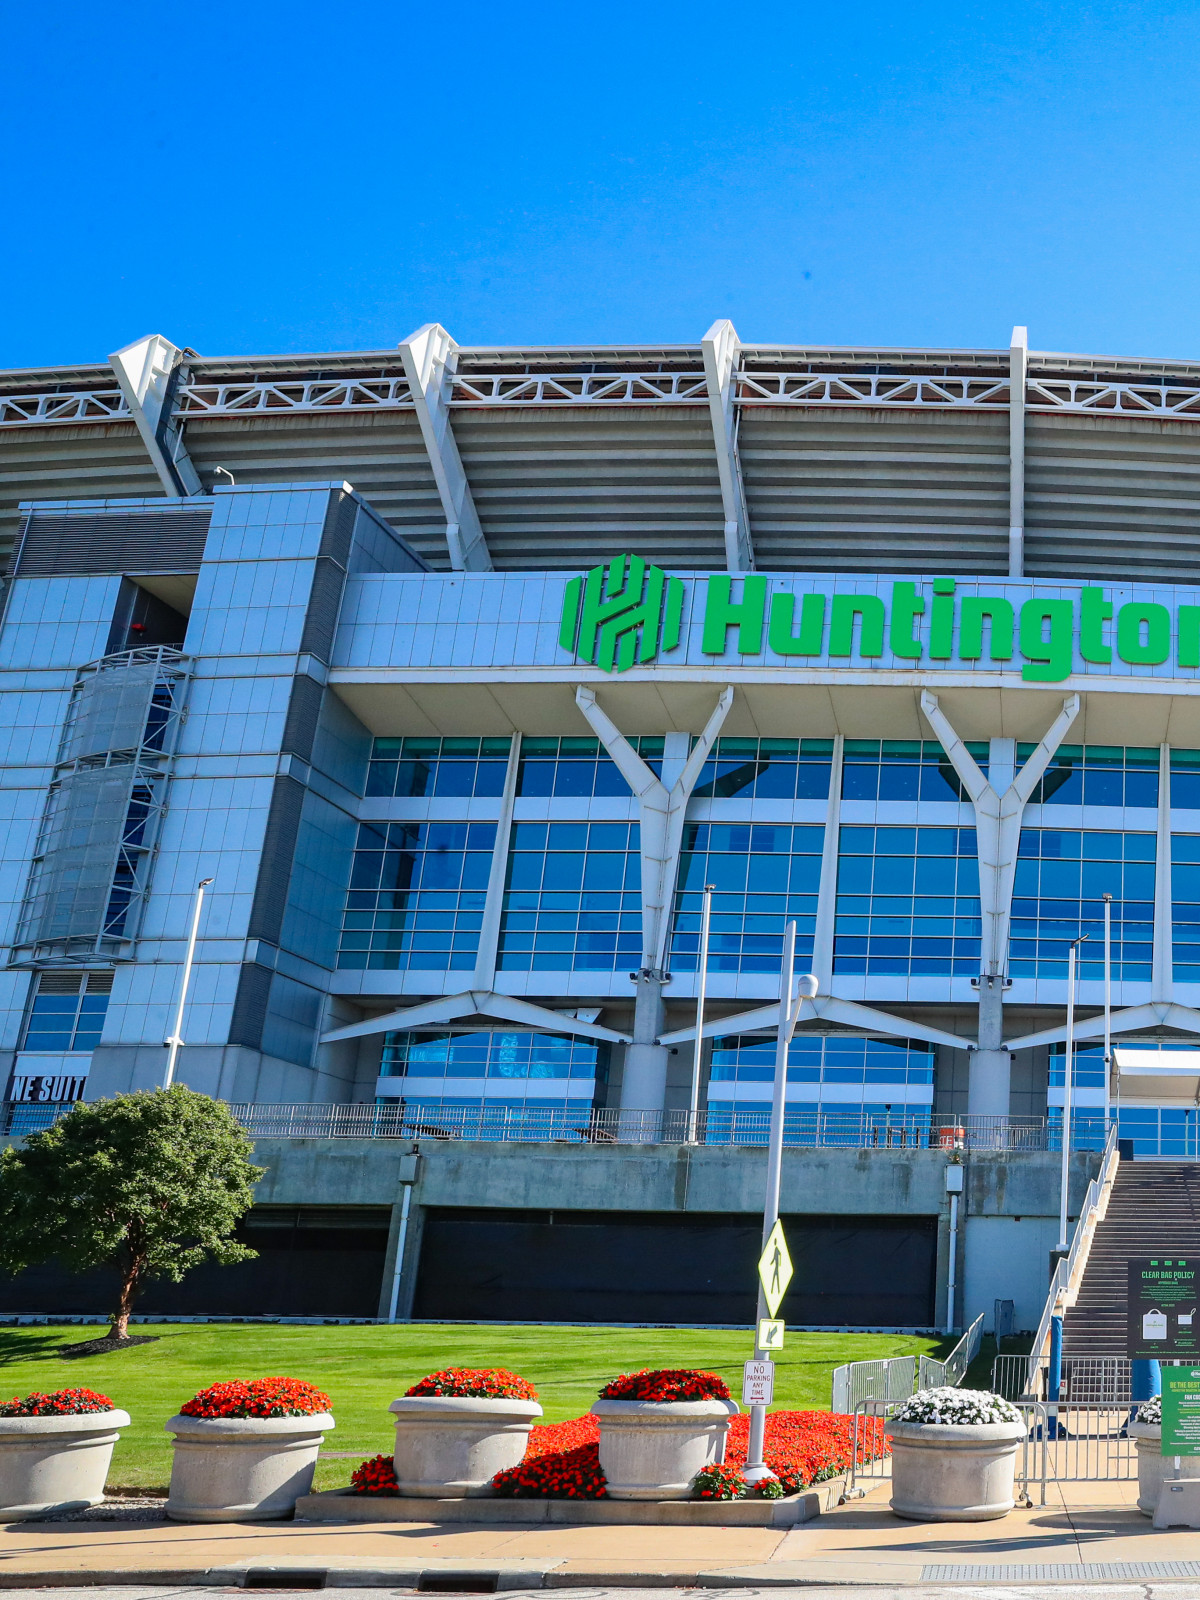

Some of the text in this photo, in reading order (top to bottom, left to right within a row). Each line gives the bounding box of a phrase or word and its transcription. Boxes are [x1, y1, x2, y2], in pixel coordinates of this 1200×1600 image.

[1141, 1271, 1195, 1279] CLEAR BAG POLICY
[753, 1365, 765, 1374] NO
[1169, 1381, 1176, 1389] BE
[1177, 1381, 1187, 1389] THE
[1187, 1381, 1200, 1389] BEST
